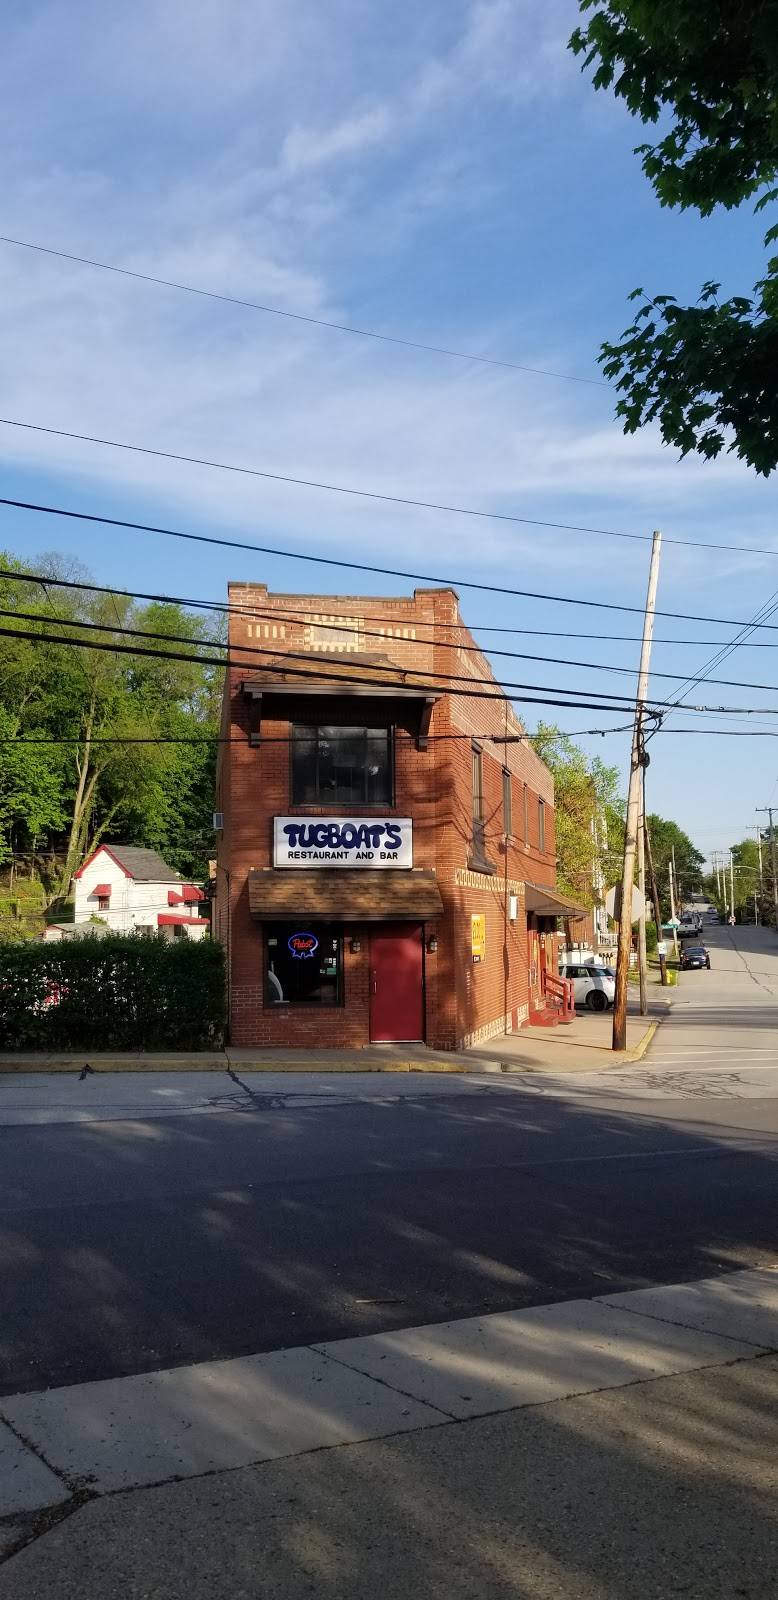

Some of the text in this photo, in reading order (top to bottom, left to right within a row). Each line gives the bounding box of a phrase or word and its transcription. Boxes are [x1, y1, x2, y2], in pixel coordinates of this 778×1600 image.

[283, 822, 402, 850] TUGBOAT'S
[287, 851, 399, 860] RESTAURANT AND BAR
